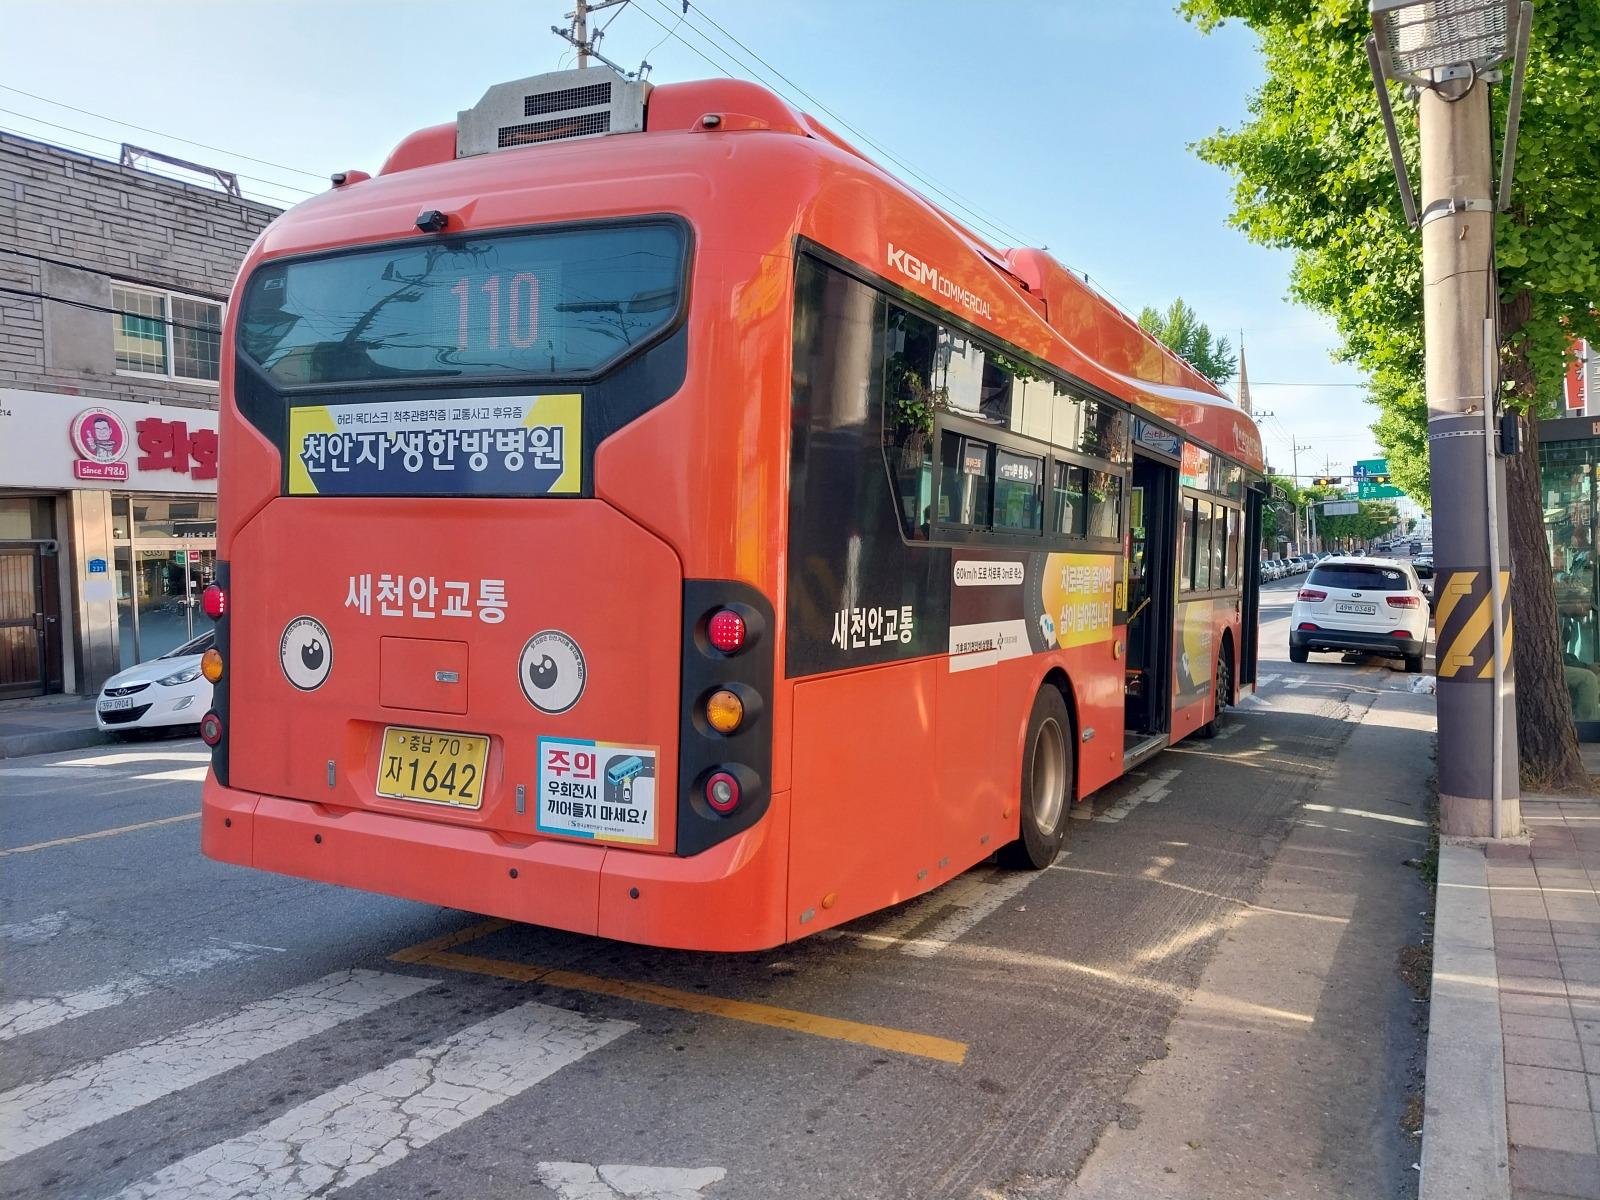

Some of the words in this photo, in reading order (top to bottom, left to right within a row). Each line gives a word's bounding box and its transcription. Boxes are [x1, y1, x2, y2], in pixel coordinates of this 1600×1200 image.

[887, 242, 938, 291] KGM
[938, 276, 992, 320] COMMERCIAL
[450, 271, 540, 352] 110
[393, 409, 447, 422] 척추관협착증
[451, 407, 490, 421] 교통사고
[492, 406, 523, 419] 후유증
[302, 428, 564, 474] 천안자생한방병원
[82, 466, 102, 474] since
[104, 466, 125, 476] 1986
[956, 567, 978, 580] 60km/h
[978, 567, 987, 580] 도로
[988, 566, 1001, 581] 차로폭
[344, 573, 509, 624] 새천안교통
[831, 605, 914, 650] 새천안교통
[409, 734, 433, 754] 충남
[438, 738, 460, 757] 70
[547, 749, 596, 780] 주의
[547, 780, 597, 800] 우회전시
[547, 799, 597, 819] 끼어들지
[600, 805, 648, 825] 마세요!
